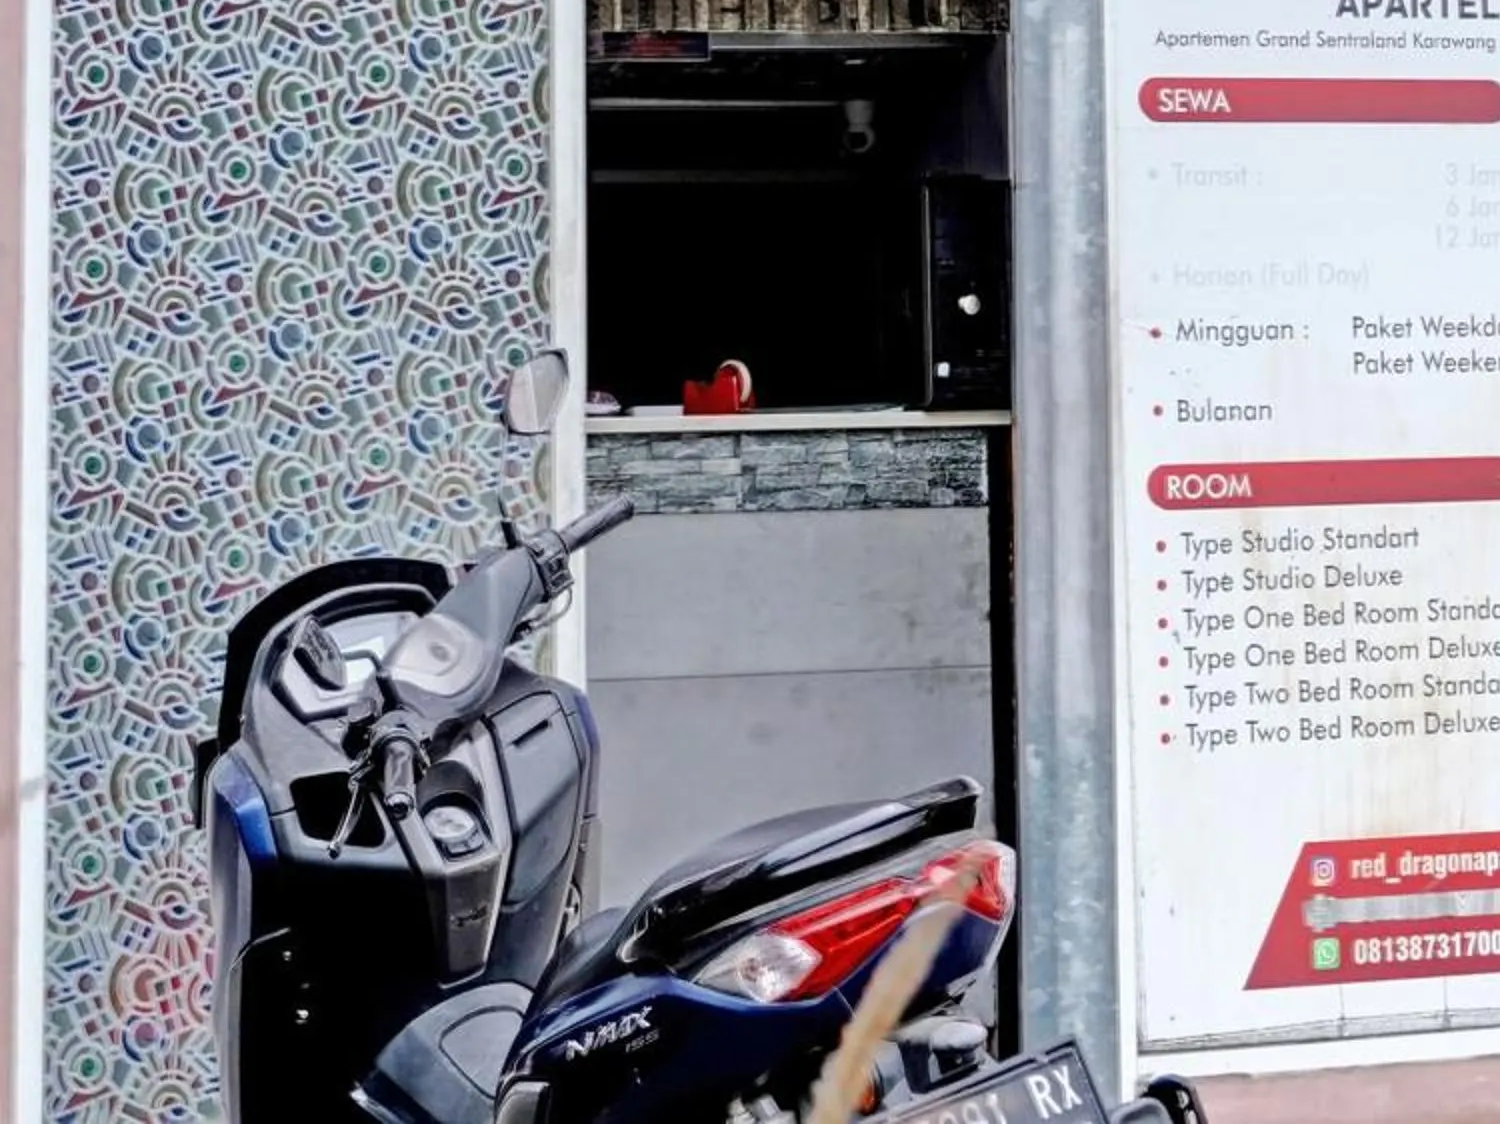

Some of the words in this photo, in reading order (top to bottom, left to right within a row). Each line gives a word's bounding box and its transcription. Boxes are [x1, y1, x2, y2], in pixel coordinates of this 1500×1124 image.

[1155, 29, 1250, 48] Apartemen
[1257, 31, 1310, 48] Grand
[1316, 31, 1407, 49] Sentraland
[1413, 33, 1496, 53] Karawang
[1158, 88, 1231, 113] SEWA
[1172, 163, 1248, 187] Transit
[1446, 164, 1458, 186] 3
[1446, 196, 1459, 218] 6
[1435, 227, 1460, 249] 12
[1261, 263, 1309, 288] (Full
[1317, 261, 1371, 290] Day)
[1176, 320, 1294, 345] Mingguan
[1352, 316, 1412, 339] Paket
[1354, 350, 1413, 374] Paket
[1177, 399, 1273, 422] Bulanan
[1166, 473, 1253, 499] ROOM
[1181, 532, 1232, 561] Type
[1242, 528, 1314, 554] Studio
[1324, 524, 1419, 551] Standart
[1182, 570, 1234, 598] Type
[1243, 566, 1315, 592] Studio
[1325, 563, 1402, 588] Deluxe
[1182, 608, 1234, 637] Type
[1244, 605, 1294, 630] One
[1304, 602, 1345, 627] Bed
[1355, 600, 1419, 624] Room
[1184, 647, 1235, 675] Type
[1245, 643, 1295, 668] One
[1305, 641, 1346, 665] Bed
[1356, 638, 1420, 663] Room
[1185, 685, 1236, 714] Type
[1245, 681, 1289, 706] Two
[1299, 679, 1340, 704] Bed
[1350, 677, 1414, 701] Room
[1185, 723, 1237, 752] Type
[1246, 719, 1290, 744] Two
[1300, 716, 1341, 742] Bed
[1350, 714, 1414, 739] Room
[1025, 1065, 1083, 1119] RX
